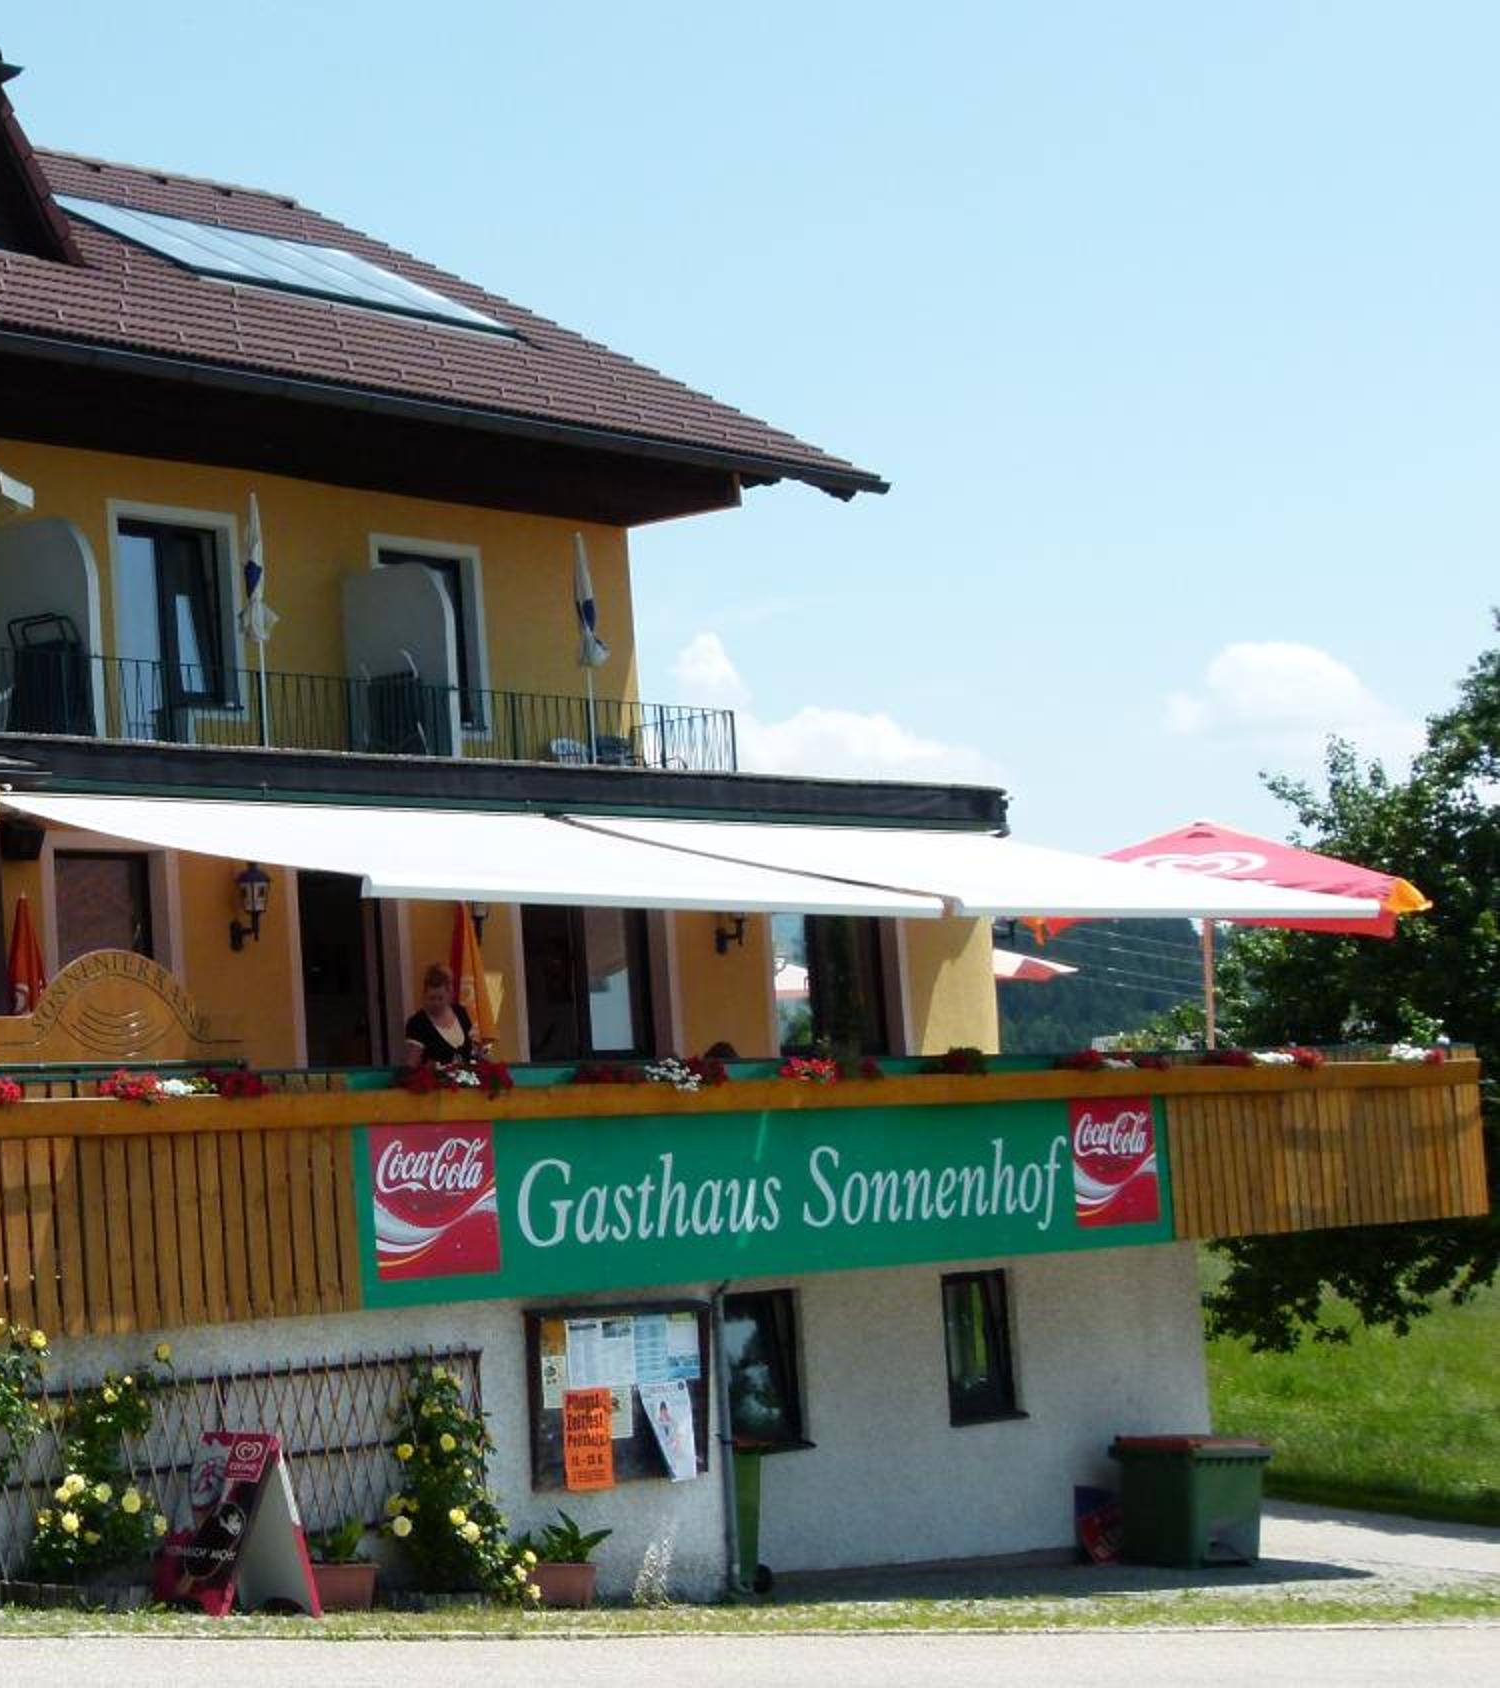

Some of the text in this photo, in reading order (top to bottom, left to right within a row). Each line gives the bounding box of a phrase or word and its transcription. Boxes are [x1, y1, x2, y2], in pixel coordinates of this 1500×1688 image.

[1074, 1110, 1147, 1158] Coca-Cola
[376, 1137, 488, 1194] Coca-Cola
[517, 1135, 1067, 1248] Gasthaus Sonnenhof
